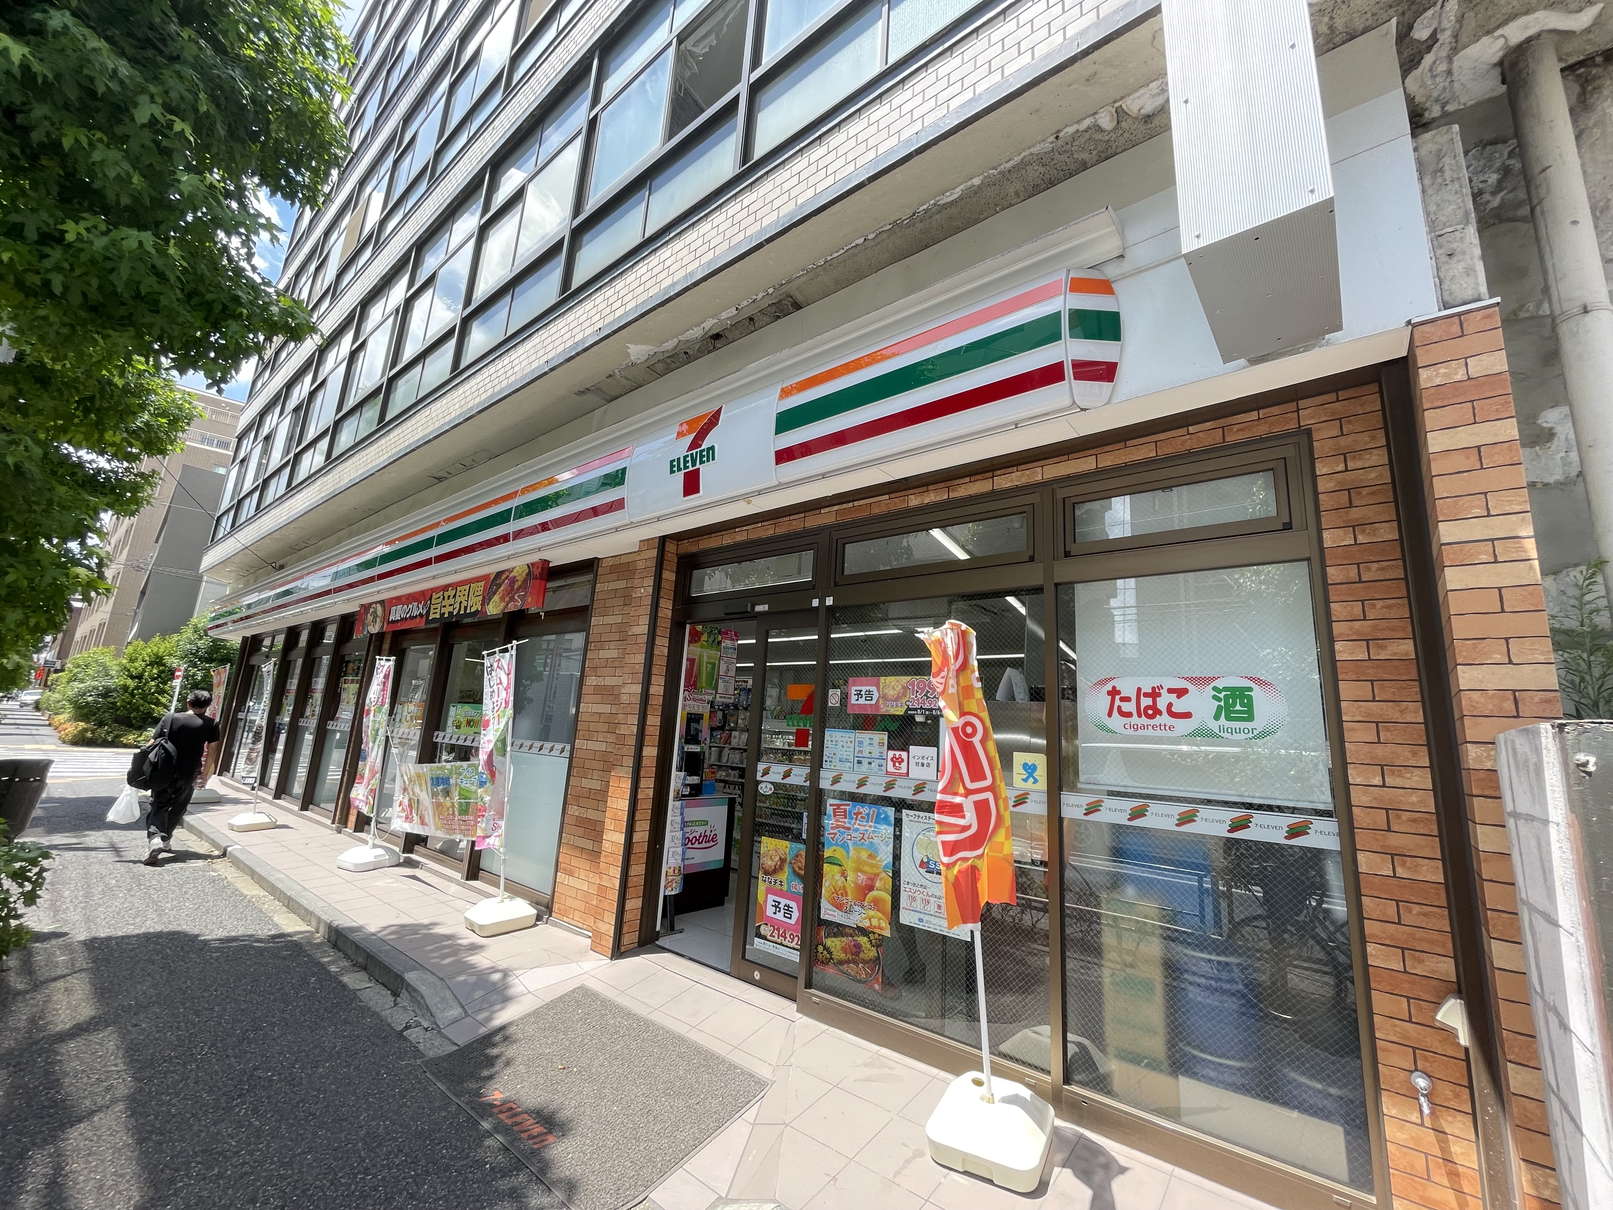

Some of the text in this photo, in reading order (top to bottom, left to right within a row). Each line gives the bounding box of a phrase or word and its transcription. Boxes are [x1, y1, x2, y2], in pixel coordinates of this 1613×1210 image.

[429, 582, 484, 619] 旨辛界隈
[853, 689, 874, 701] 予告
[1107, 684, 1255, 722] たばこ 酒
[1123, 721, 1257, 735] cigarette liquor
[771, 898, 794, 920] 予告
